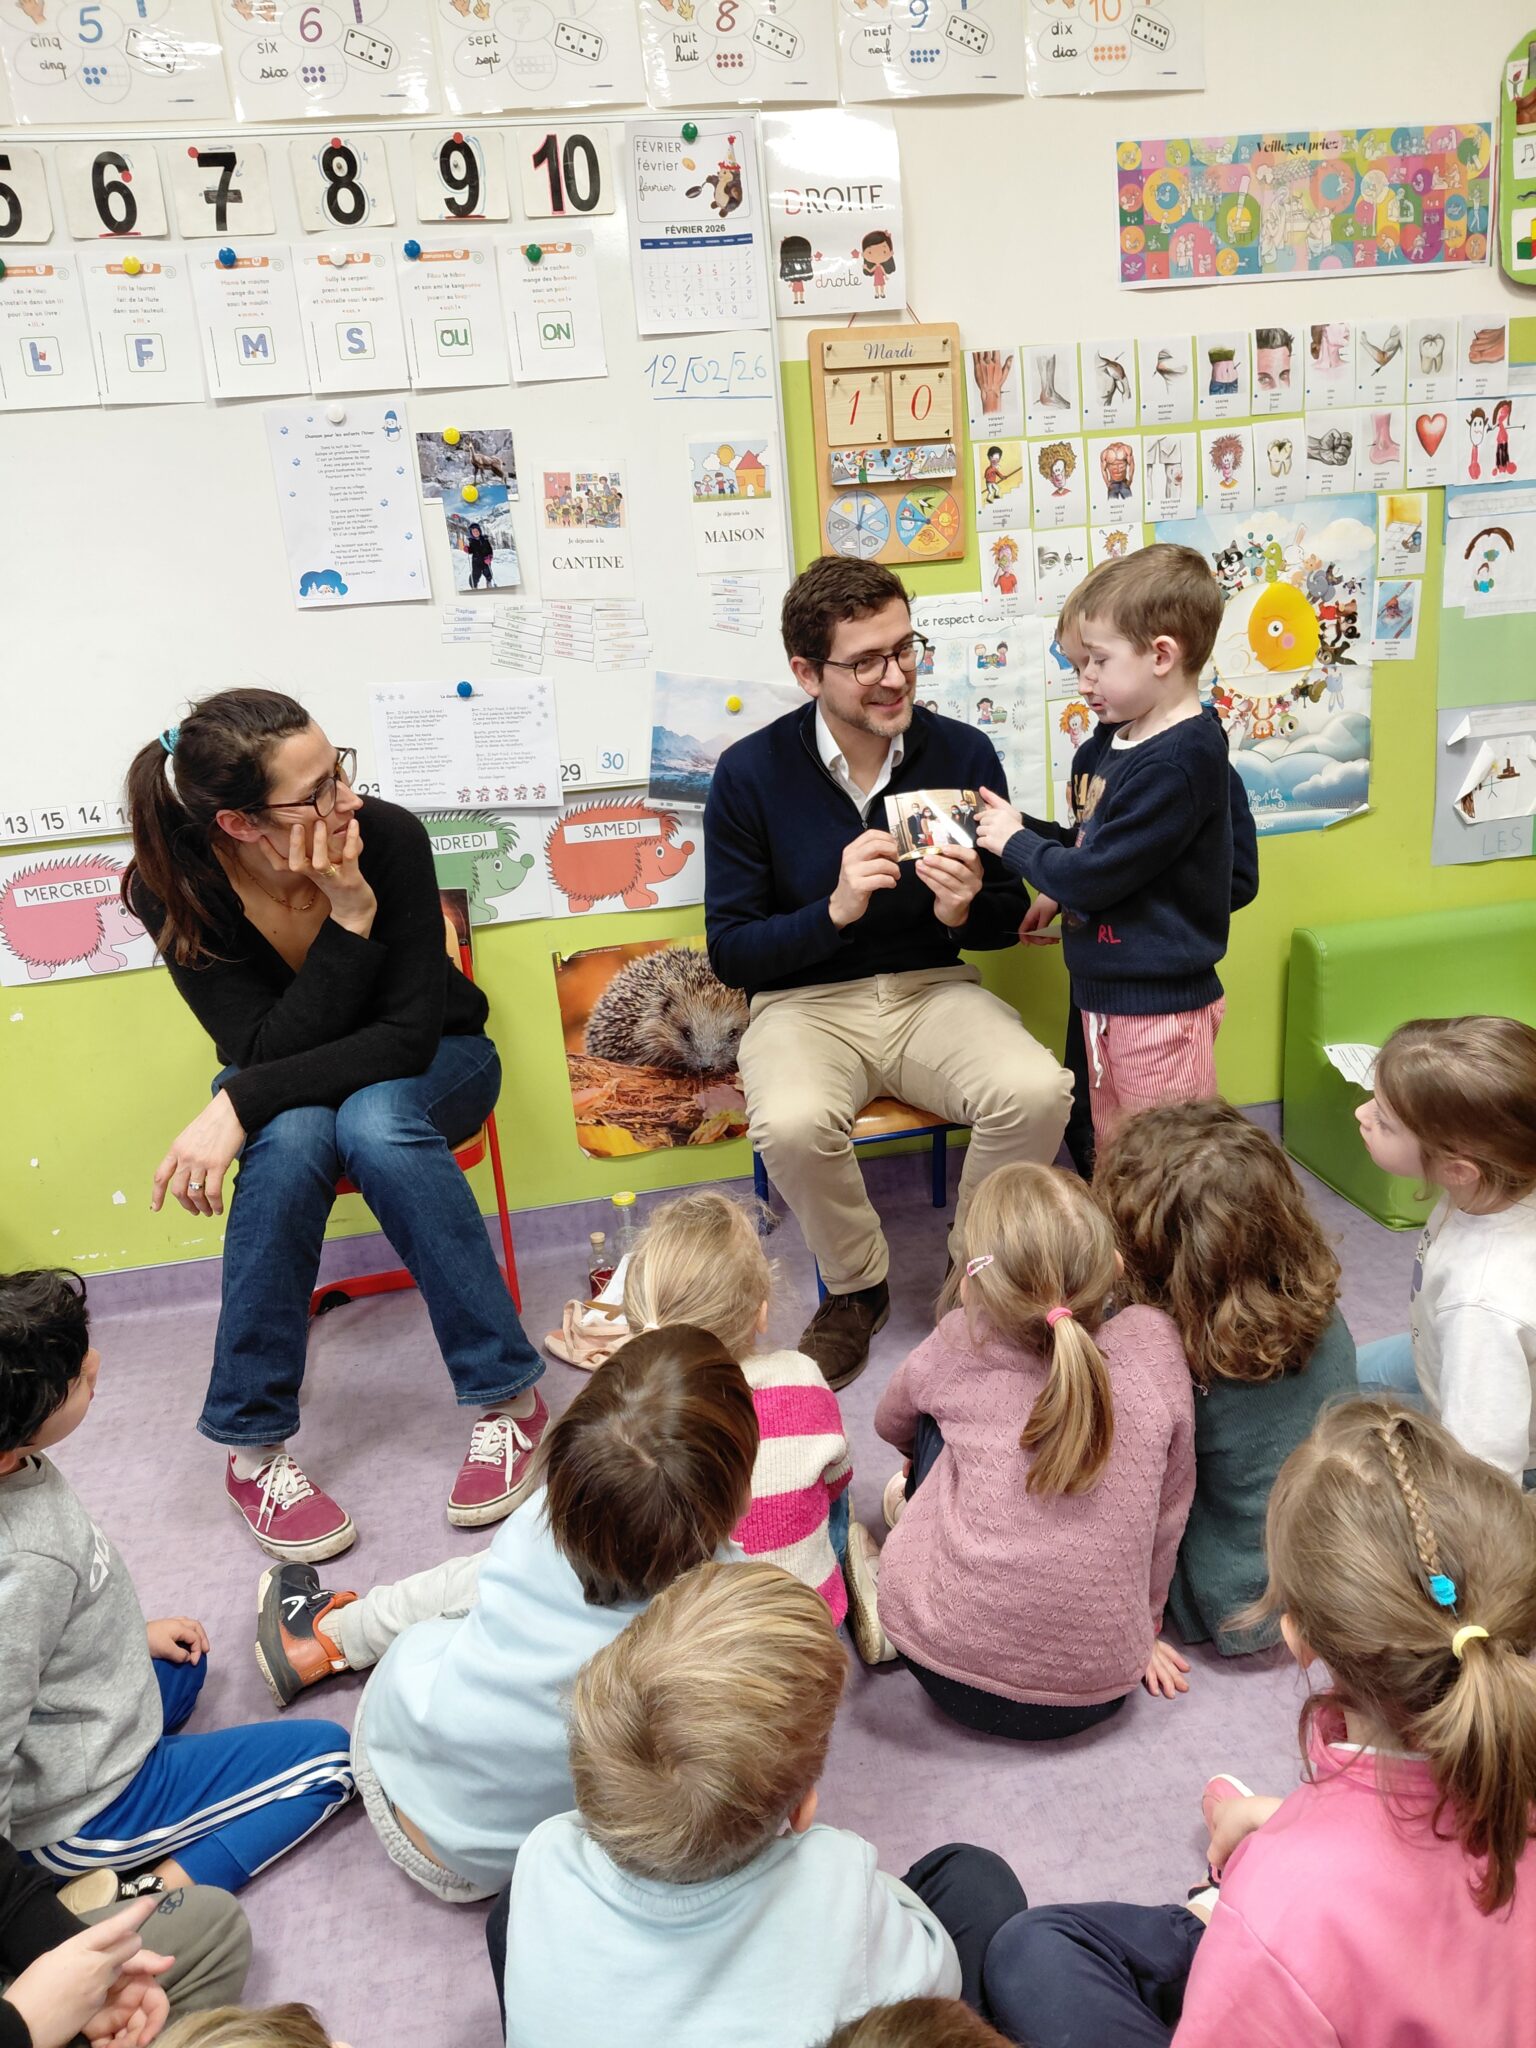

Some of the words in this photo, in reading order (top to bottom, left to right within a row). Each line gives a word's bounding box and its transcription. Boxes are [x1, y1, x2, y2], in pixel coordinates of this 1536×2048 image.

[715, 0, 739, 32] 8
[909, 0, 929, 28] 9
[1090, 0, 1122, 23] 10
[78, 7, 103, 43] 5
[299, 7, 322, 42] 6
[863, 25, 892, 38] neuf
[1051, 22, 1073, 36] dix
[30, 35, 63, 52] cinq
[257, 39, 278, 55] six
[467, 32, 499, 48] sept
[672, 32, 698, 44] huit
[475, 53, 501, 74] sept
[675, 45, 700, 63] huit
[39, 60, 67, 80] cinq
[636, 140, 682, 154] FÉVRIER
[1256, 140, 1295, 154] Veillez
[1308, 138, 1339, 153] priez
[531, 133, 601, 215] 10
[637, 158, 680, 171] février
[322, 144, 366, 225] 8
[440, 138, 480, 217] 9
[91, 151, 137, 234] 6
[196, 152, 243, 231] 7
[639, 175, 677, 201] février
[784, 185, 883, 215] DROITE
[665, 225, 703, 235] FÉVRIER
[705, 224, 726, 233] 2026
[816, 269, 863, 288] droite
[440, 328, 469, 347] OU
[542, 322, 571, 340] ON
[242, 333, 269, 358] M
[346, 328, 367, 354] S
[29, 342, 52, 371] L
[135, 338, 153, 367] F
[863, 343, 915, 360] Mardi
[848, 390, 860, 425] 1
[911, 384, 932, 420] 0
[705, 527, 765, 543] MAISON
[552, 556, 624, 569] CANTINE
[917, 617, 929, 627] Le
[933, 614, 975, 628] respect
[601, 752, 624, 770] 30
[561, 764, 582, 782] 29
[5, 815, 29, 834] 13
[41, 811, 65, 831] 15
[78, 806, 102, 824] 14
[583, 821, 642, 839] SAMEDI
[430, 833, 488, 851] NDREDI
[1482, 826, 1523, 857] LES
[24, 878, 112, 902] MERCREDI
[1098, 925, 1122, 944] RL
